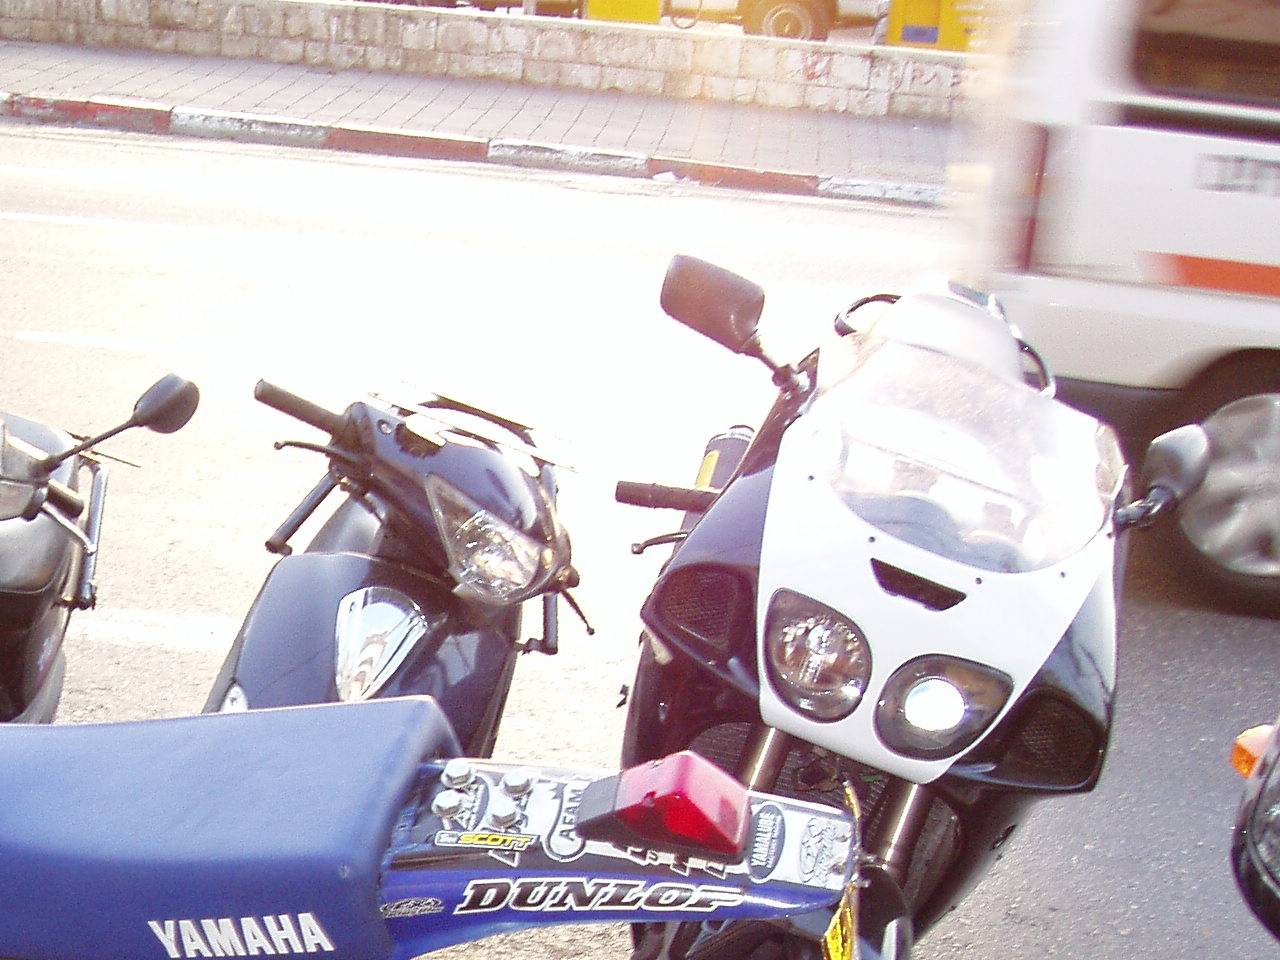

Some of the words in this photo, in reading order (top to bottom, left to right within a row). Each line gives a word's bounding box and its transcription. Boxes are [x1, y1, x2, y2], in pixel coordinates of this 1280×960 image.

[457, 832, 534, 850] SCOTT
[453, 877, 741, 915] DUNLOP
[147, 912, 335, 959] YAMAHA
